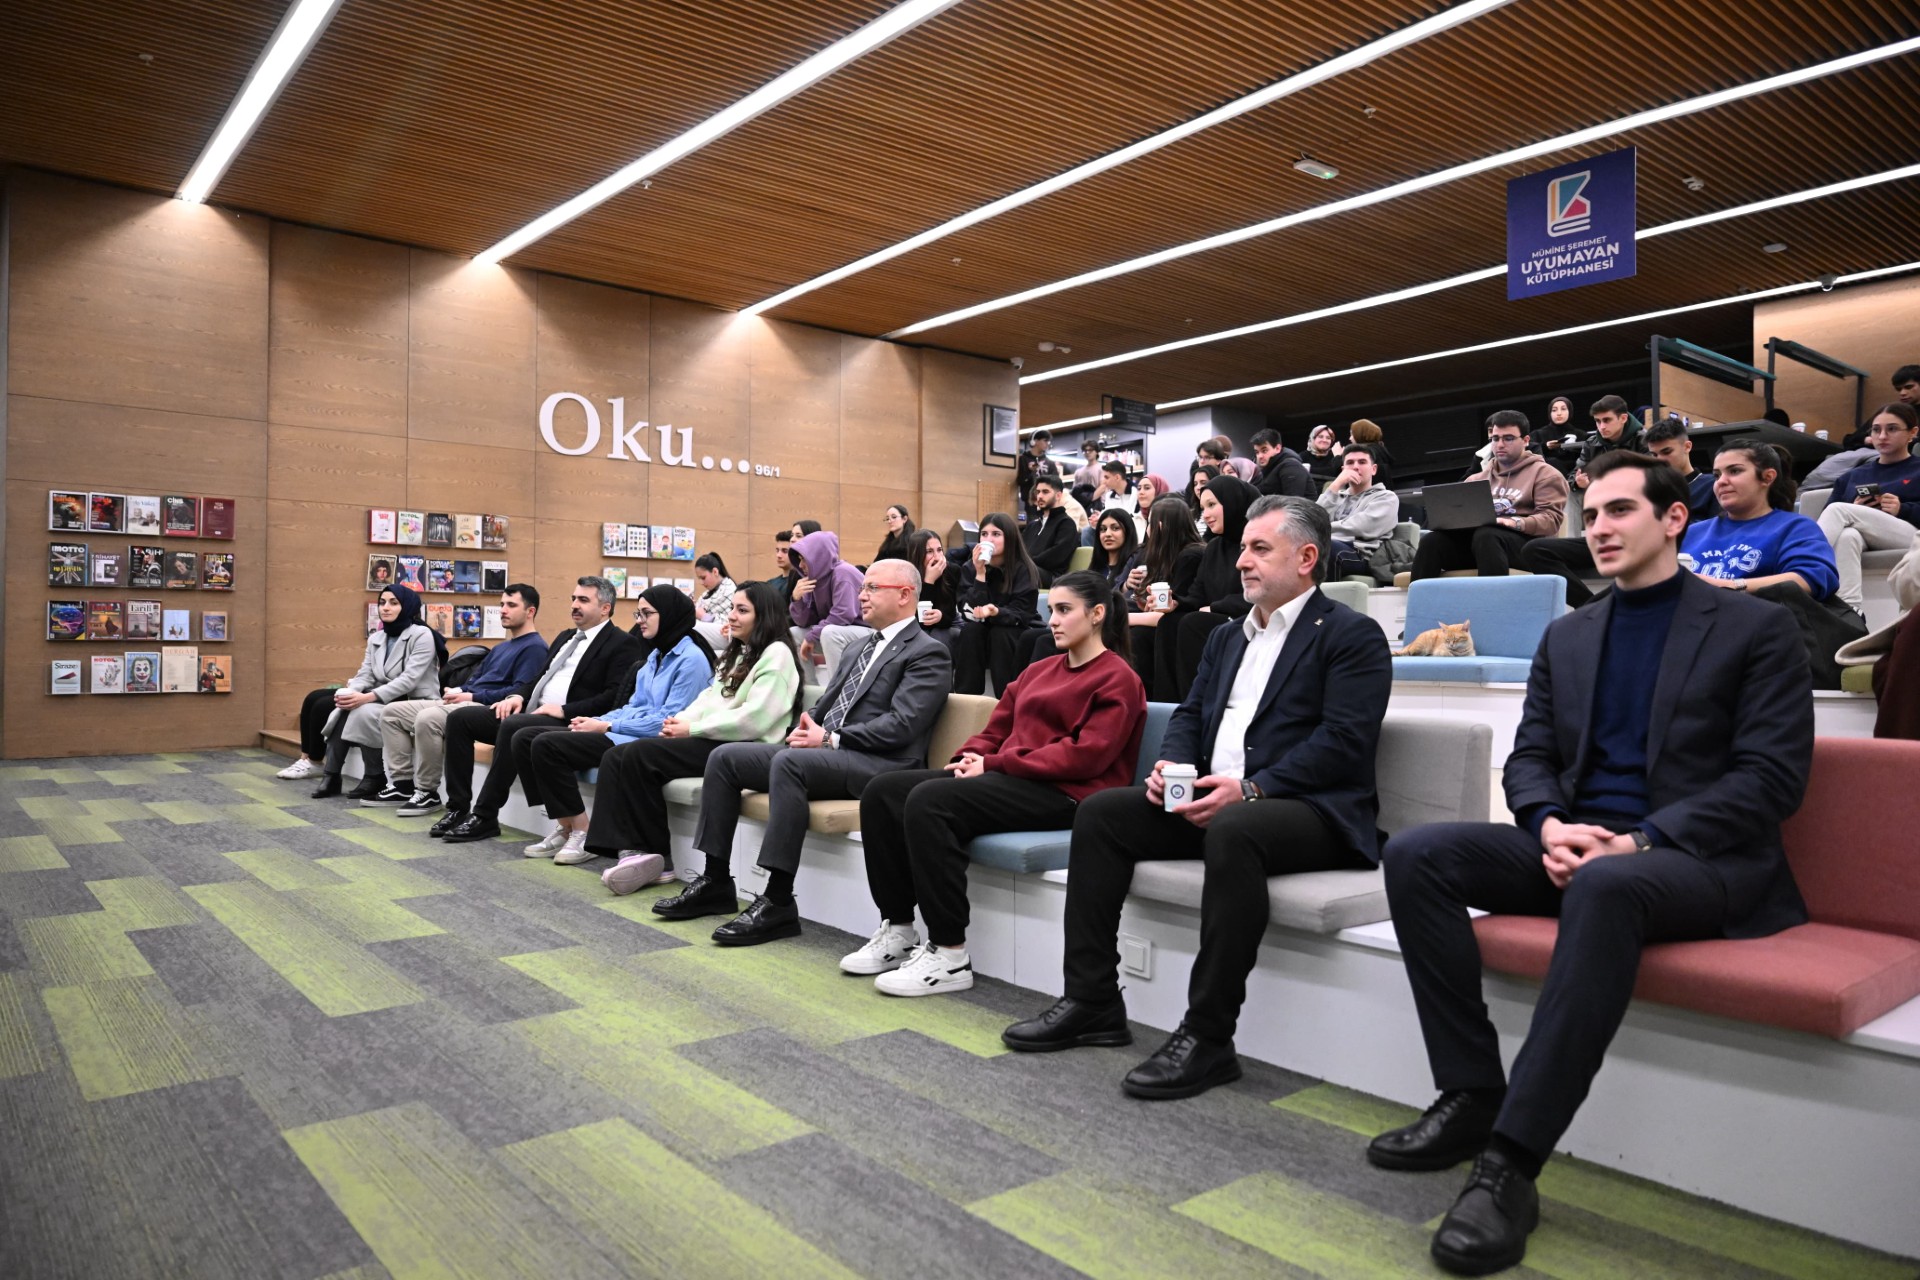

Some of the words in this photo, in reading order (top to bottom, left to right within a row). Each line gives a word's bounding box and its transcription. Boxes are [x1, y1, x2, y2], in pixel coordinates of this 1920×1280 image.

[1521, 242, 1620, 274] UYUMAYAN
[1531, 244, 1566, 259] MÜMİNE
[1567, 235, 1607, 251] ŞEREMET
[1526, 257, 1614, 286] KÜTÜPHANESİ
[538, 392, 750, 474] Oku...
[754, 464, 781, 478] 96/1
[1737, 543, 1752, 551] IN
